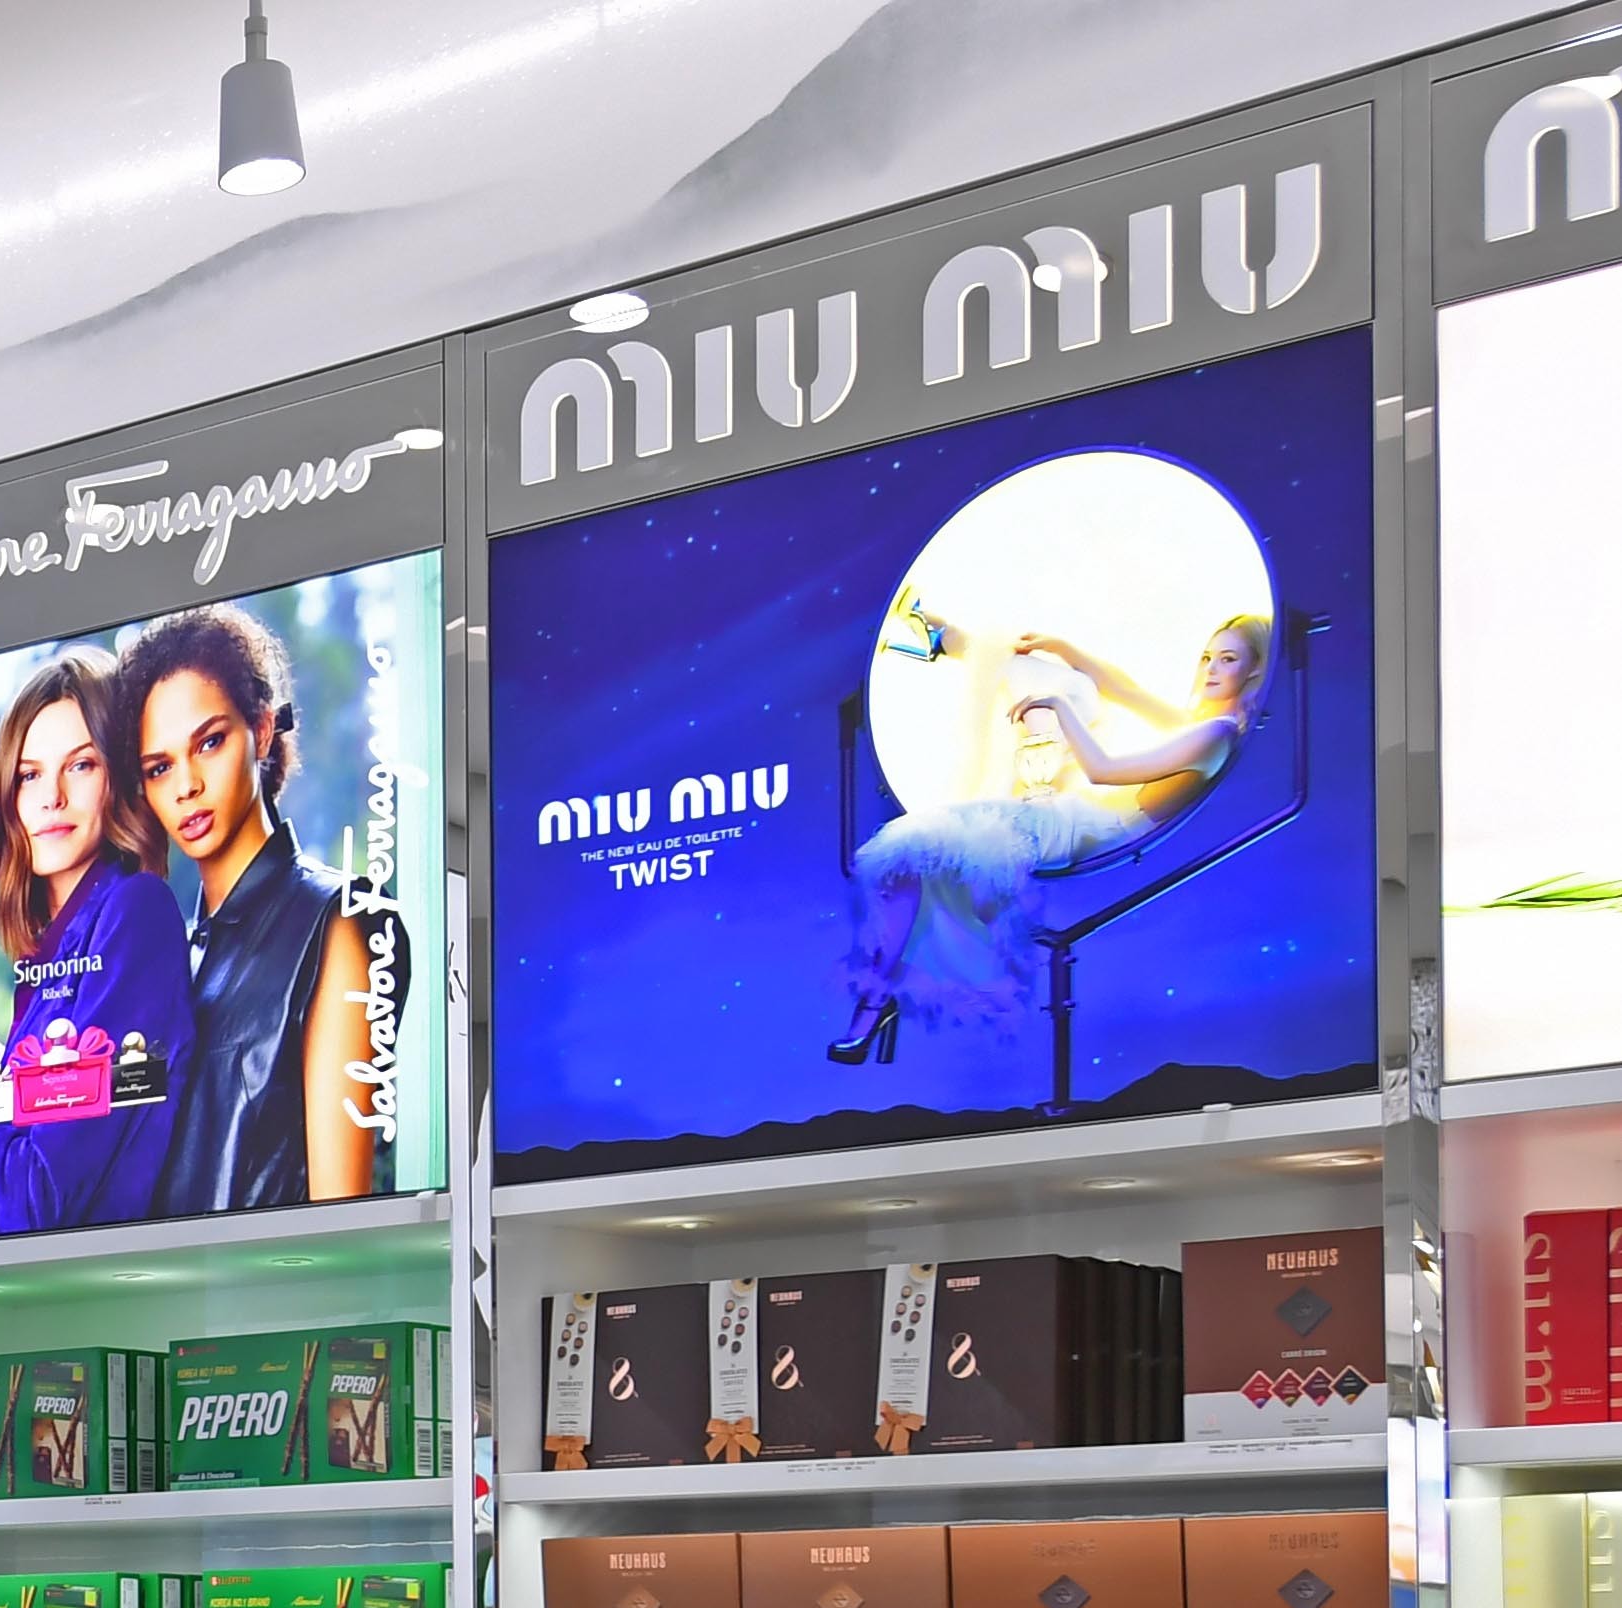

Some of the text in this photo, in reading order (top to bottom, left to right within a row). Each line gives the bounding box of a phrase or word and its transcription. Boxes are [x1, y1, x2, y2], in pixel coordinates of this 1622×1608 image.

[63, 440, 408, 586] Ferragamo
[580, 826, 743, 863] THE NEW EAU DE TOILETTE
[609, 849, 714, 890] TWIST
[342, 642, 430, 1143] Salvatore Ferragamo
[13, 951, 103, 988] Signorina
[42, 984, 75, 1001] Ribelle
[1266, 1247, 1340, 1271] NEUHAUS
[330, 1374, 376, 1396] PEPERO
[34, 1396, 76, 1416] PEPERO
[177, 1389, 289, 1442] PEPERO
[609, 1552, 667, 1570] NEUHAUS
[810, 1546, 870, 1564] NEUHAUS
